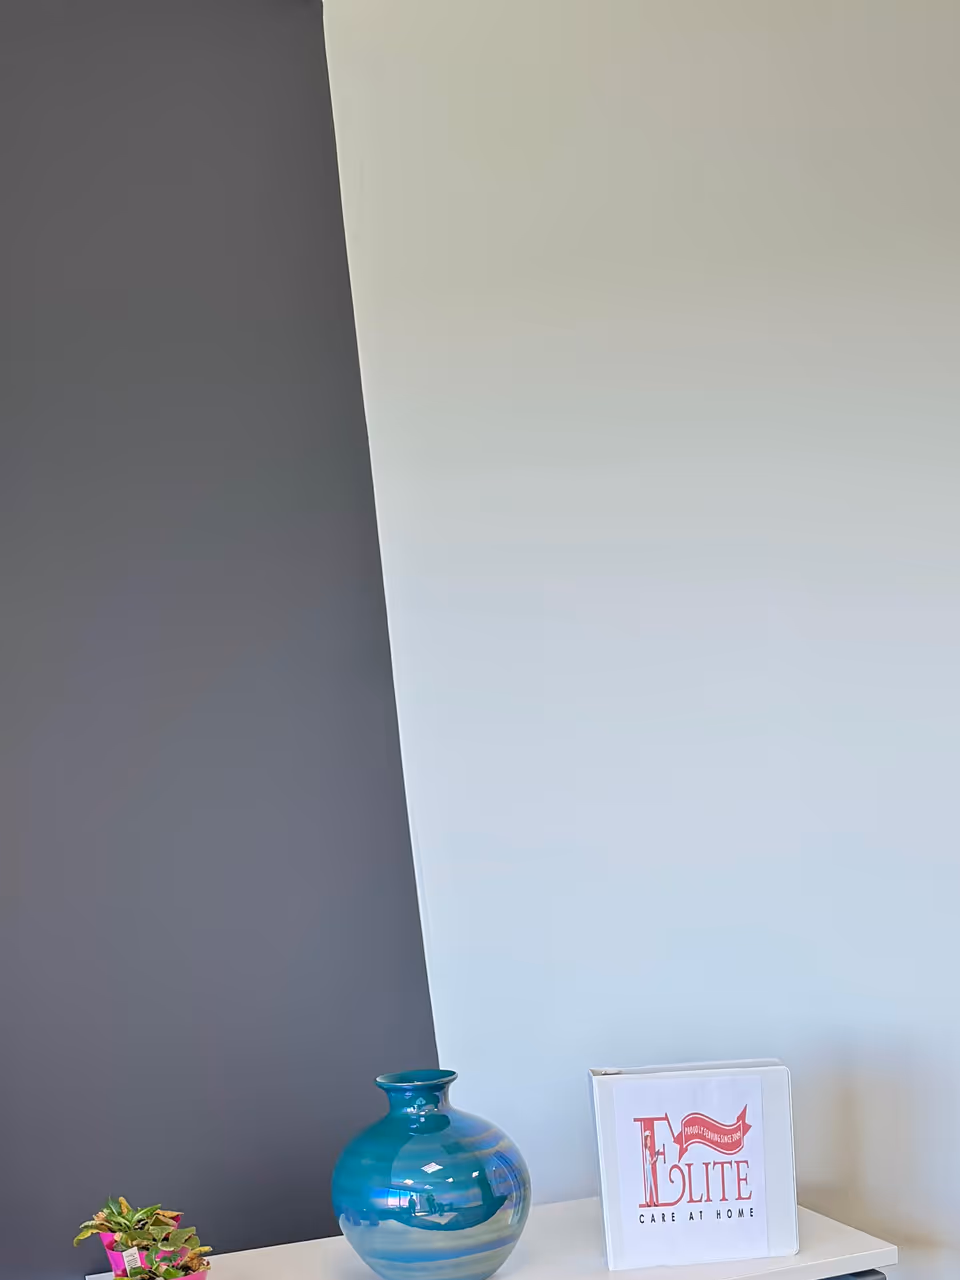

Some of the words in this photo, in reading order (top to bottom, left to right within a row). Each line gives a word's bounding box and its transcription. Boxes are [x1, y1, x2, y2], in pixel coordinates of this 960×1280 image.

[633, 1112, 752, 1208] ELITE
[639, 1213, 676, 1224] CARE
[689, 1211, 703, 1221] AT
[716, 1207, 754, 1219] HOME
